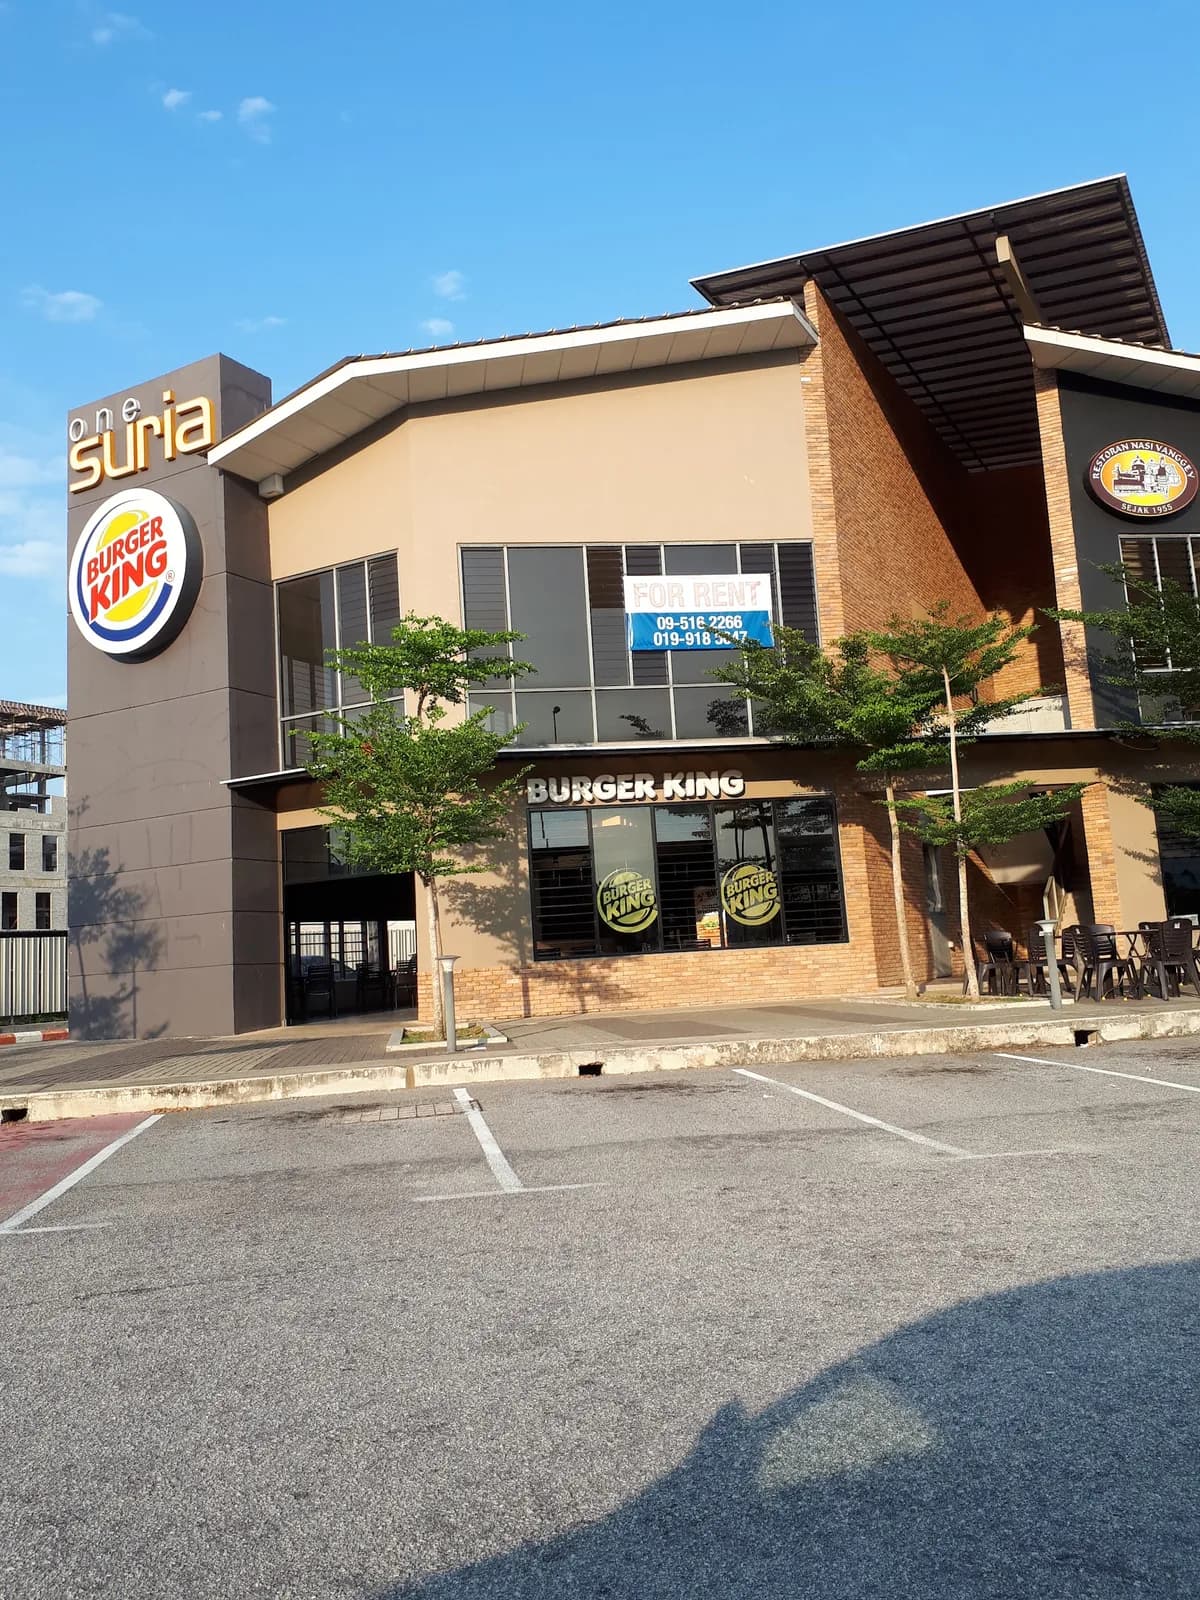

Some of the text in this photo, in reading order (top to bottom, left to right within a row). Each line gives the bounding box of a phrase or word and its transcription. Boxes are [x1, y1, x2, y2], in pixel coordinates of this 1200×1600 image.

[69, 397, 141, 442] one
[70, 389, 216, 494] suria
[1092, 442, 1196, 480] RESTORAN NASI VANGGEY
[1121, 503, 1173, 514] SEJAK 1955
[87, 515, 163, 585] BURGER
[89, 540, 167, 624] KING
[633, 581, 761, 608] FOR RENT
[656, 615, 743, 630] 09-516 2266
[653, 631, 711, 646] 019-918
[527, 769, 746, 804] BURGER KING
[603, 878, 652, 904] BURGER
[726, 871, 775, 898] BURGER
[729, 883, 778, 914] KING
[605, 889, 655, 921] KING
